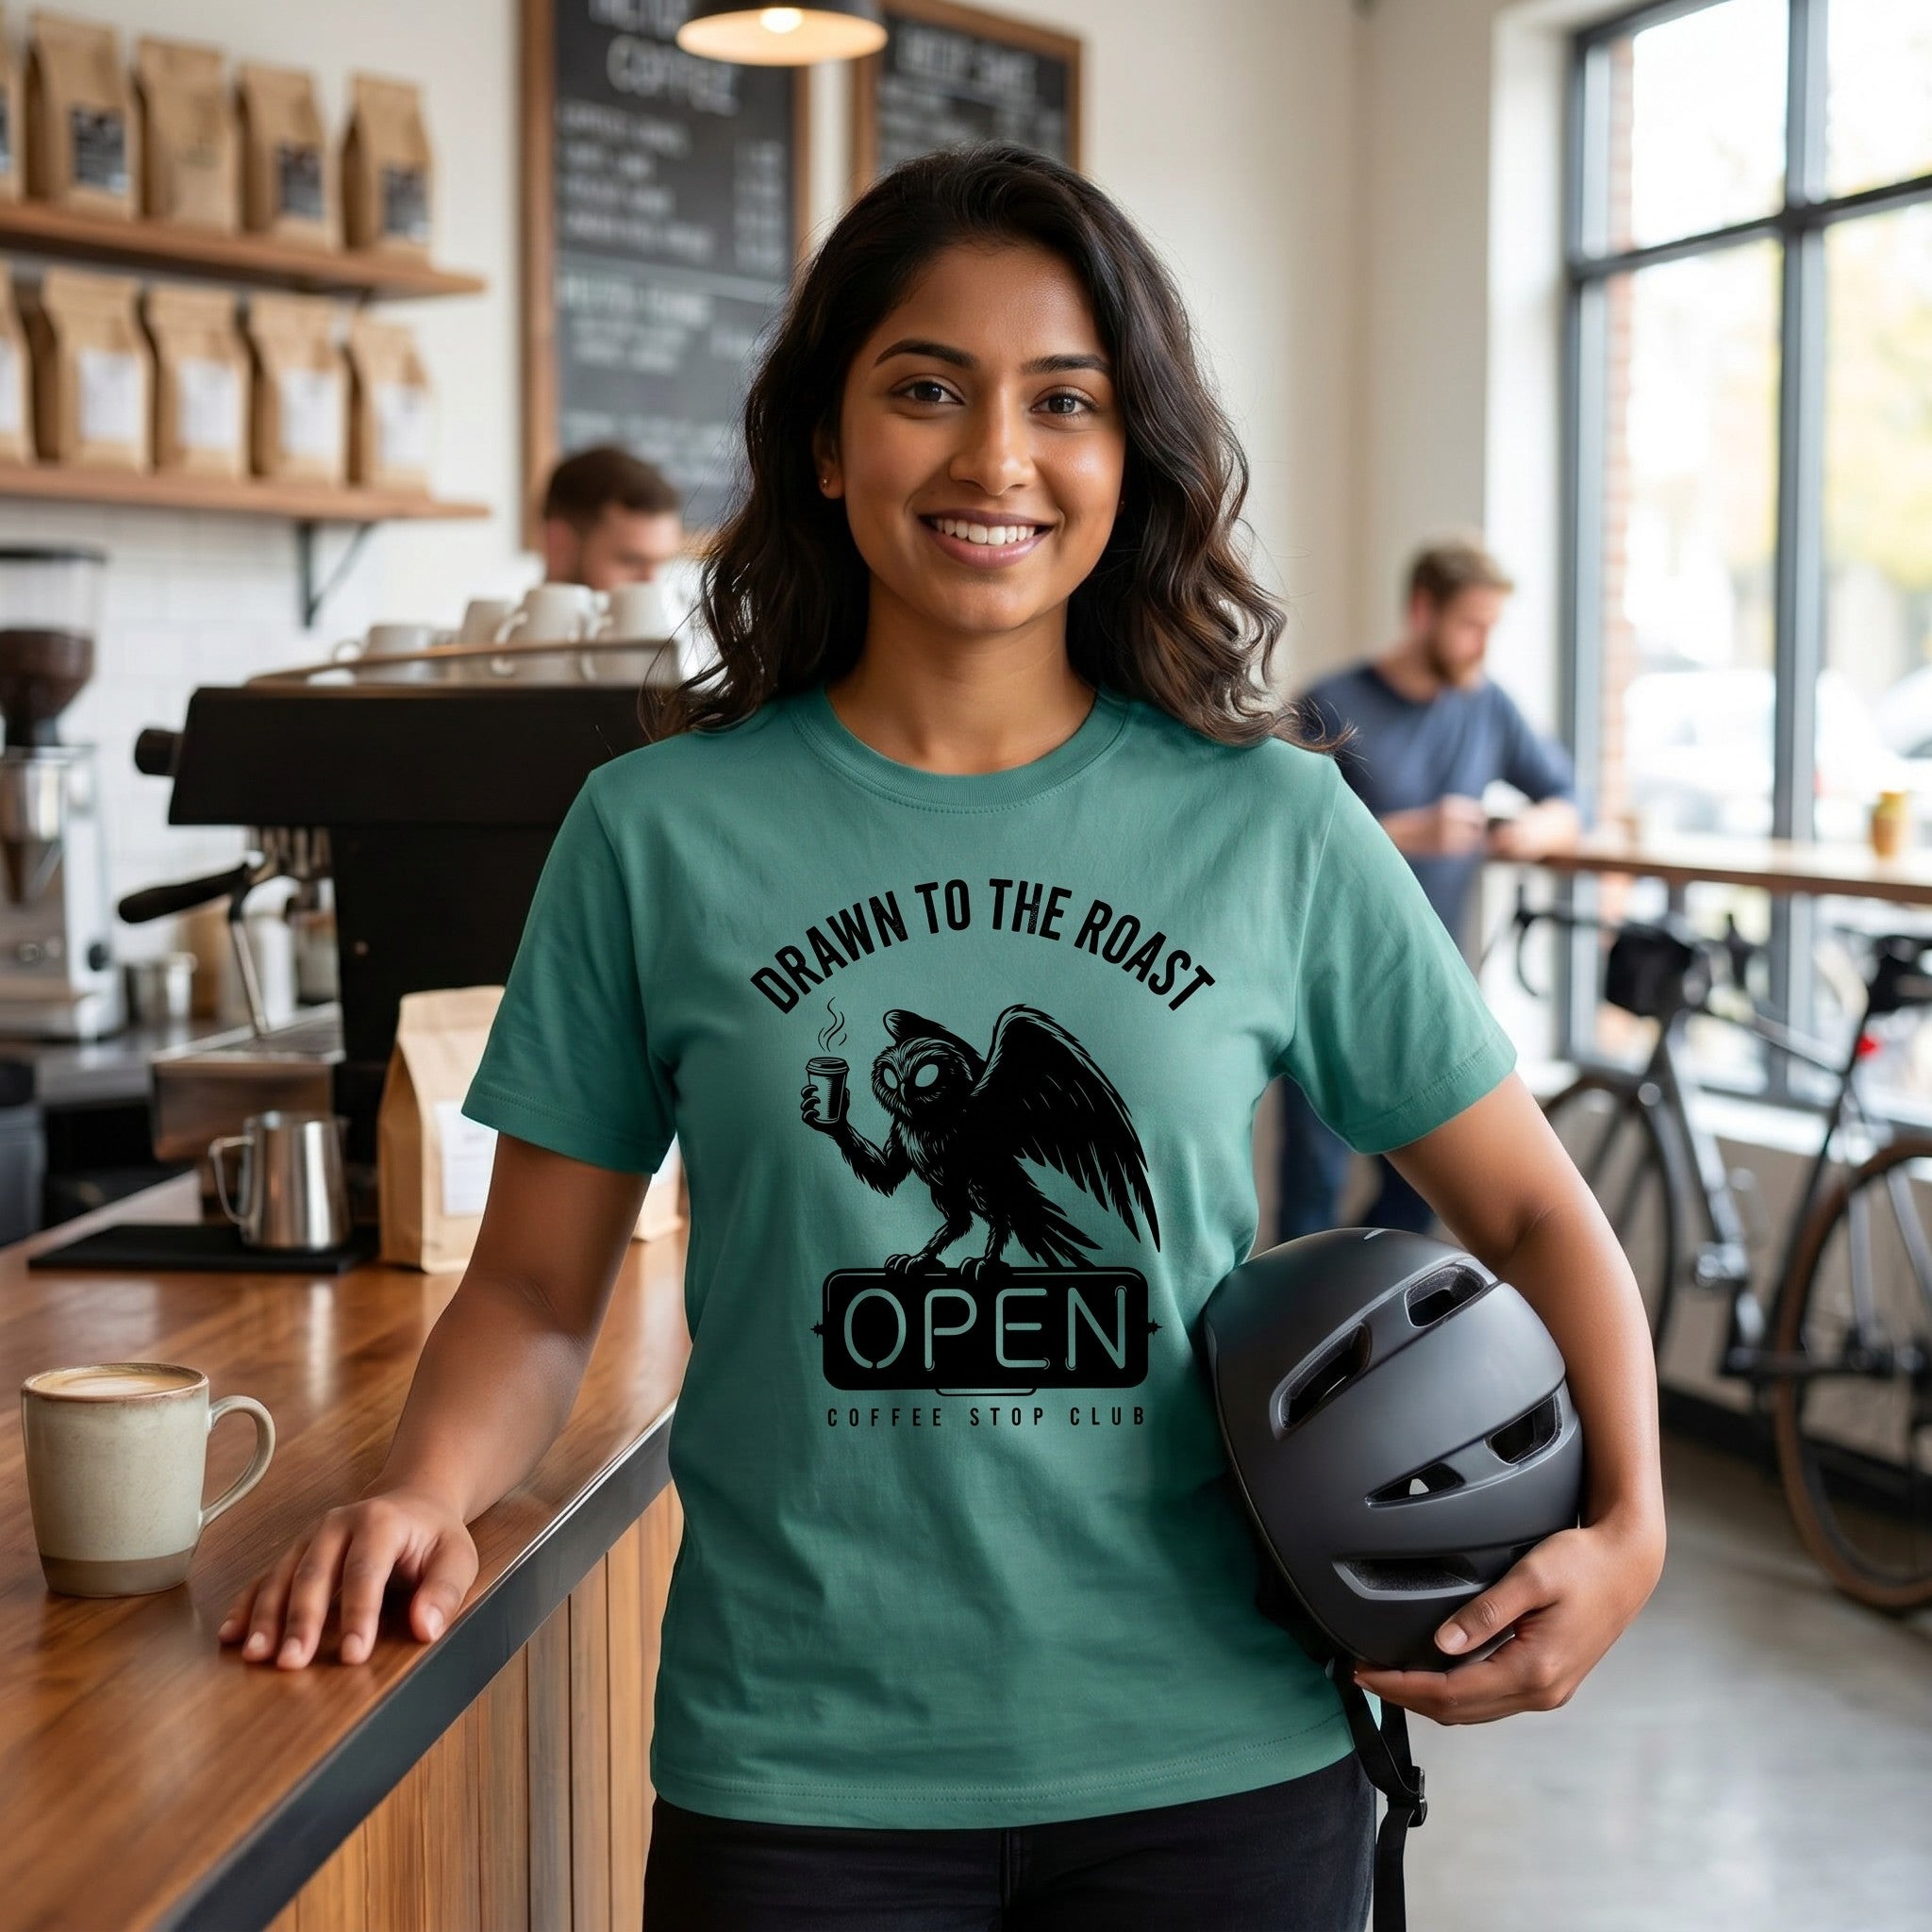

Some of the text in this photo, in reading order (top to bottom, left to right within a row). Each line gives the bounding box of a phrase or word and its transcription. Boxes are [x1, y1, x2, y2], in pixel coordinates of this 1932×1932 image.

[750, 878, 1216, 1015] DRAWN TO THE ROAST
[843, 1287, 1126, 1370] OPEN
[827, 1405, 1145, 1428] COFFEE STOP CLUB
